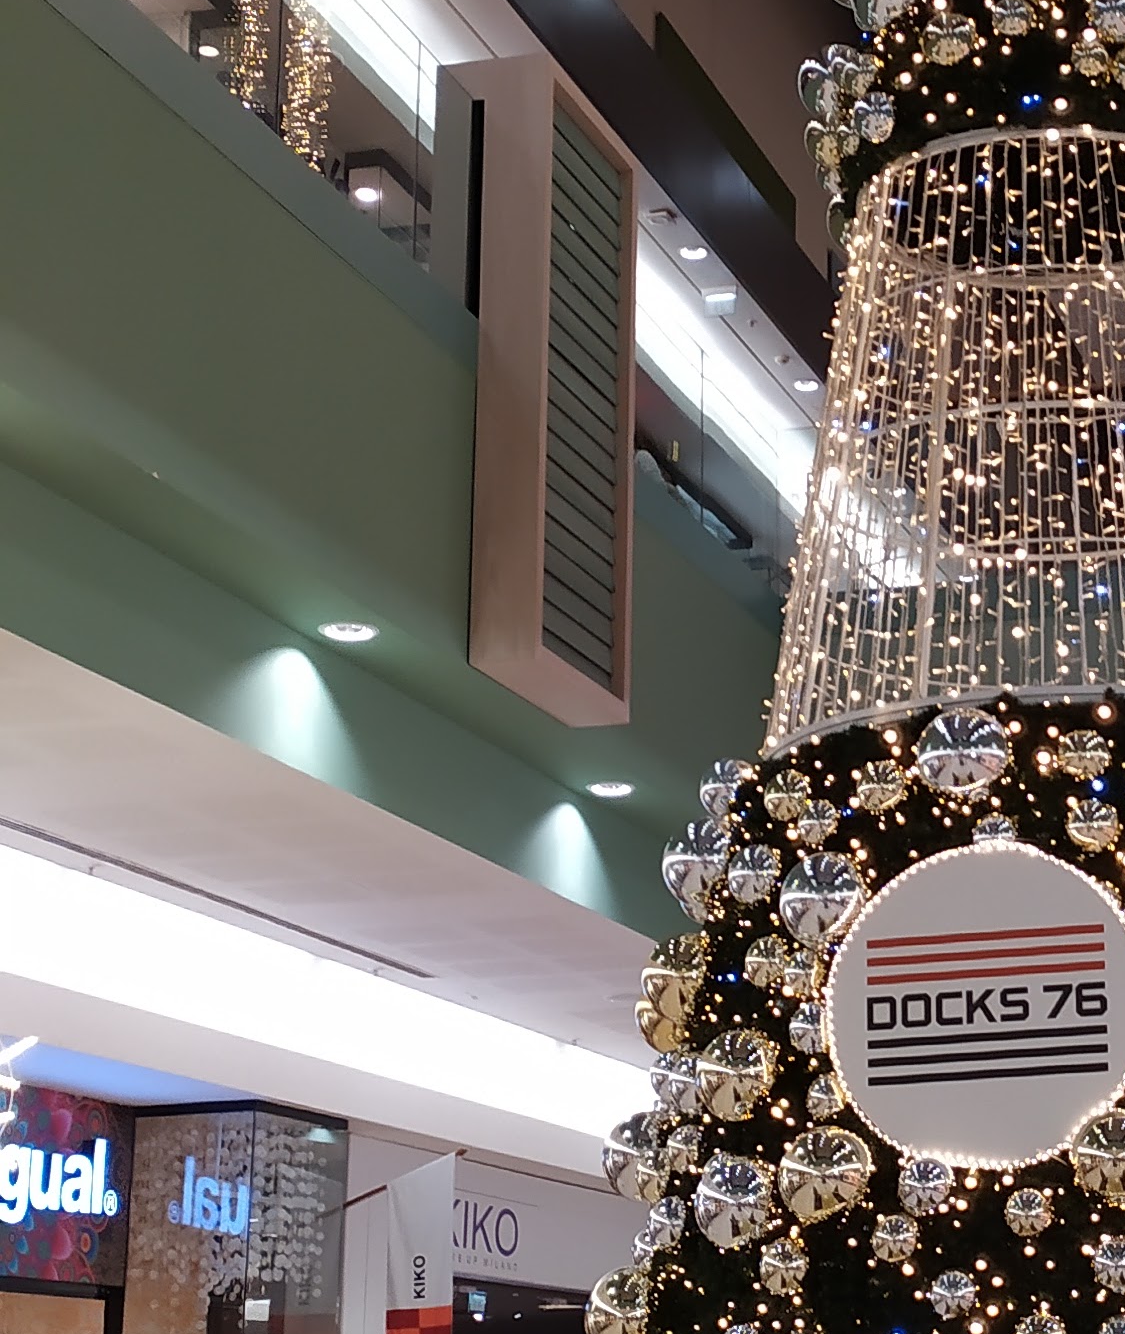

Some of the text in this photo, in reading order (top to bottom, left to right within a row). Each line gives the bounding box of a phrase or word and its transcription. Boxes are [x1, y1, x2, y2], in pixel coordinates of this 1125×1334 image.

[866, 981, 1108, 1031] DOCKS 76
[412, 1255, 426, 1299] KIKO
